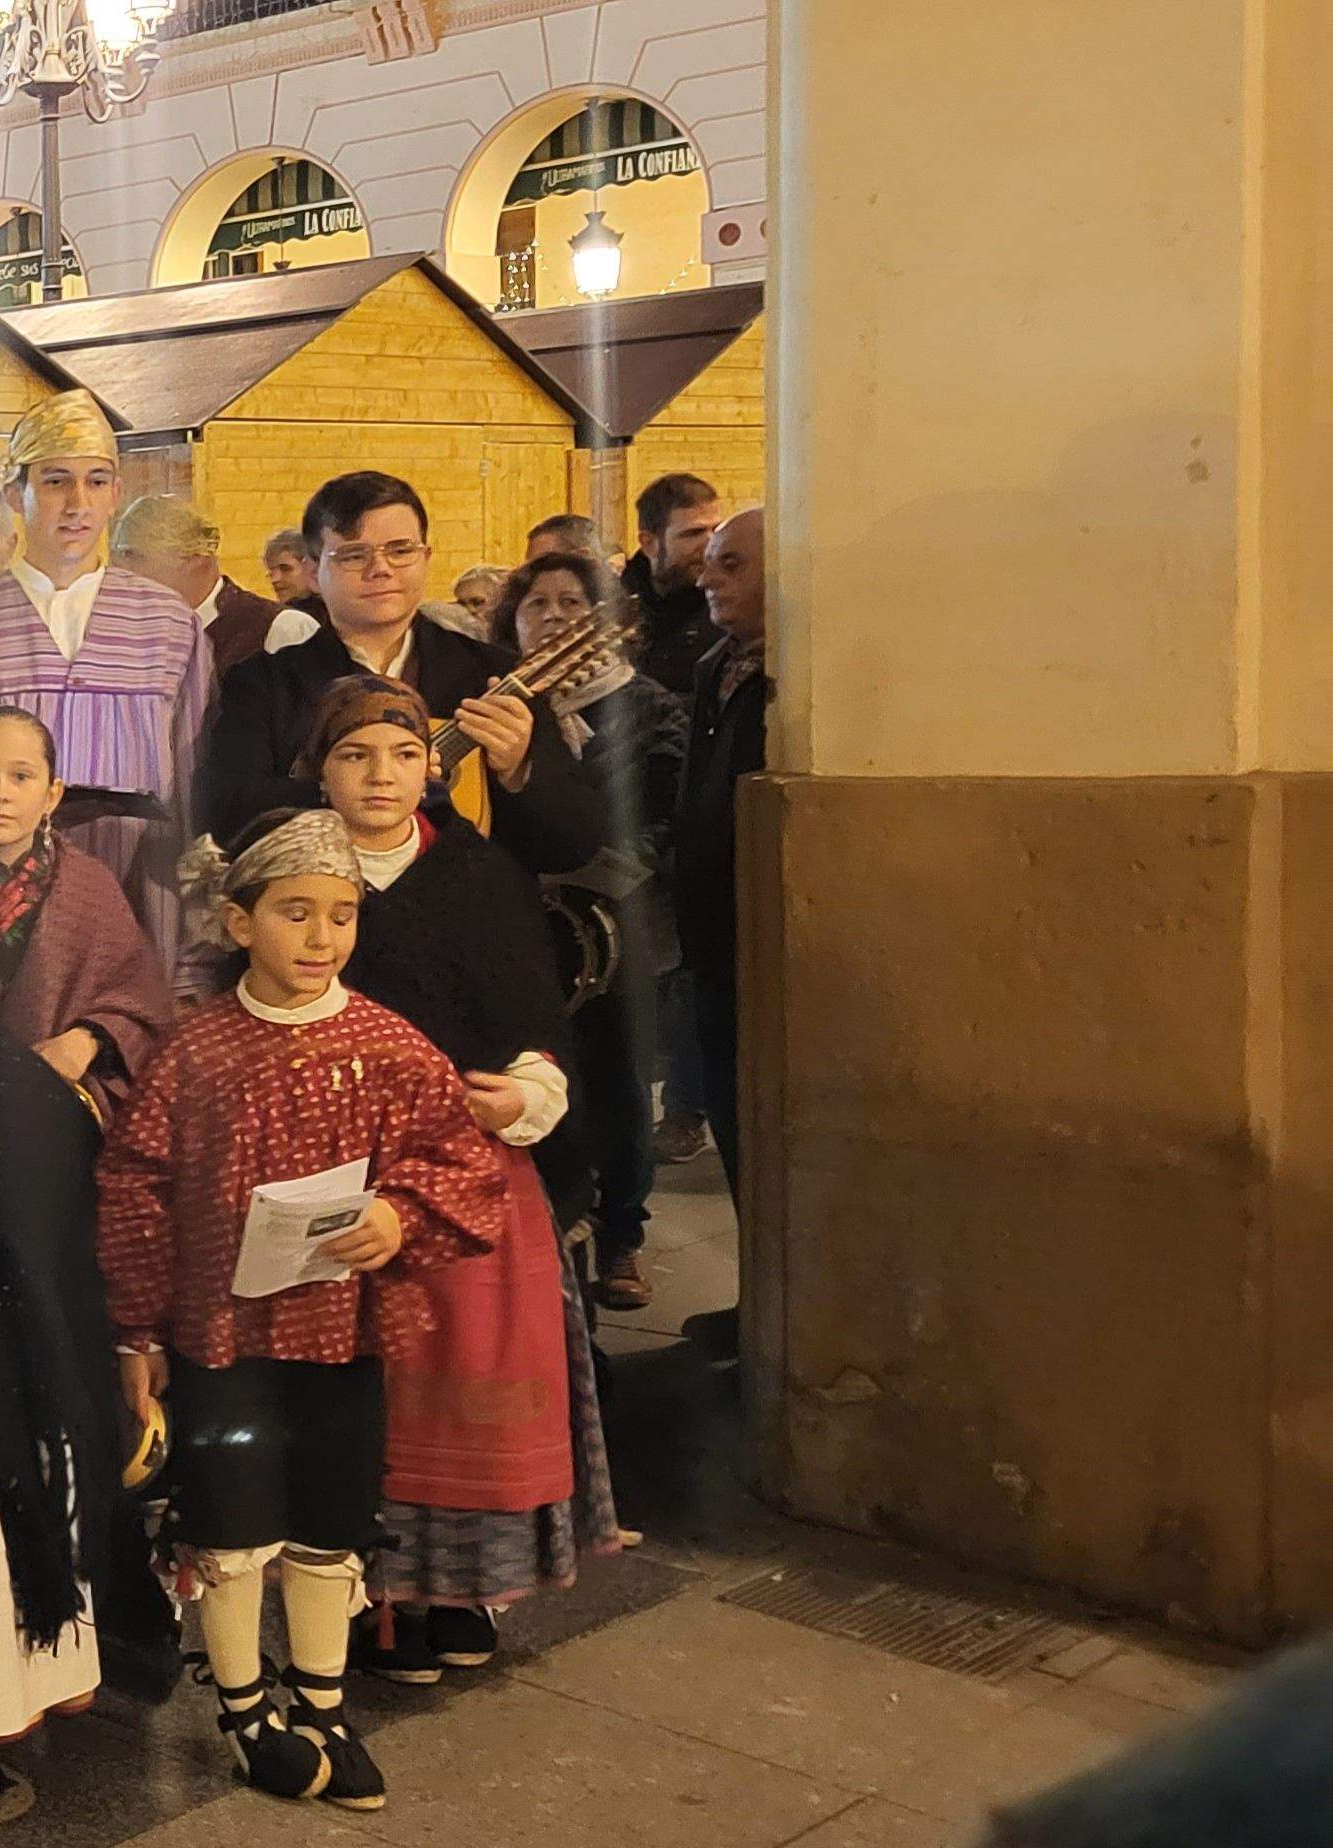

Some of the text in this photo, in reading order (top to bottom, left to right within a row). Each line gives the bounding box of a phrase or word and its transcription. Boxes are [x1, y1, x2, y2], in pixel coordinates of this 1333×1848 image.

[616, 156, 634, 181] LA
[638, 147, 700, 177] CONFIAN
[304, 211, 319, 236] LA
